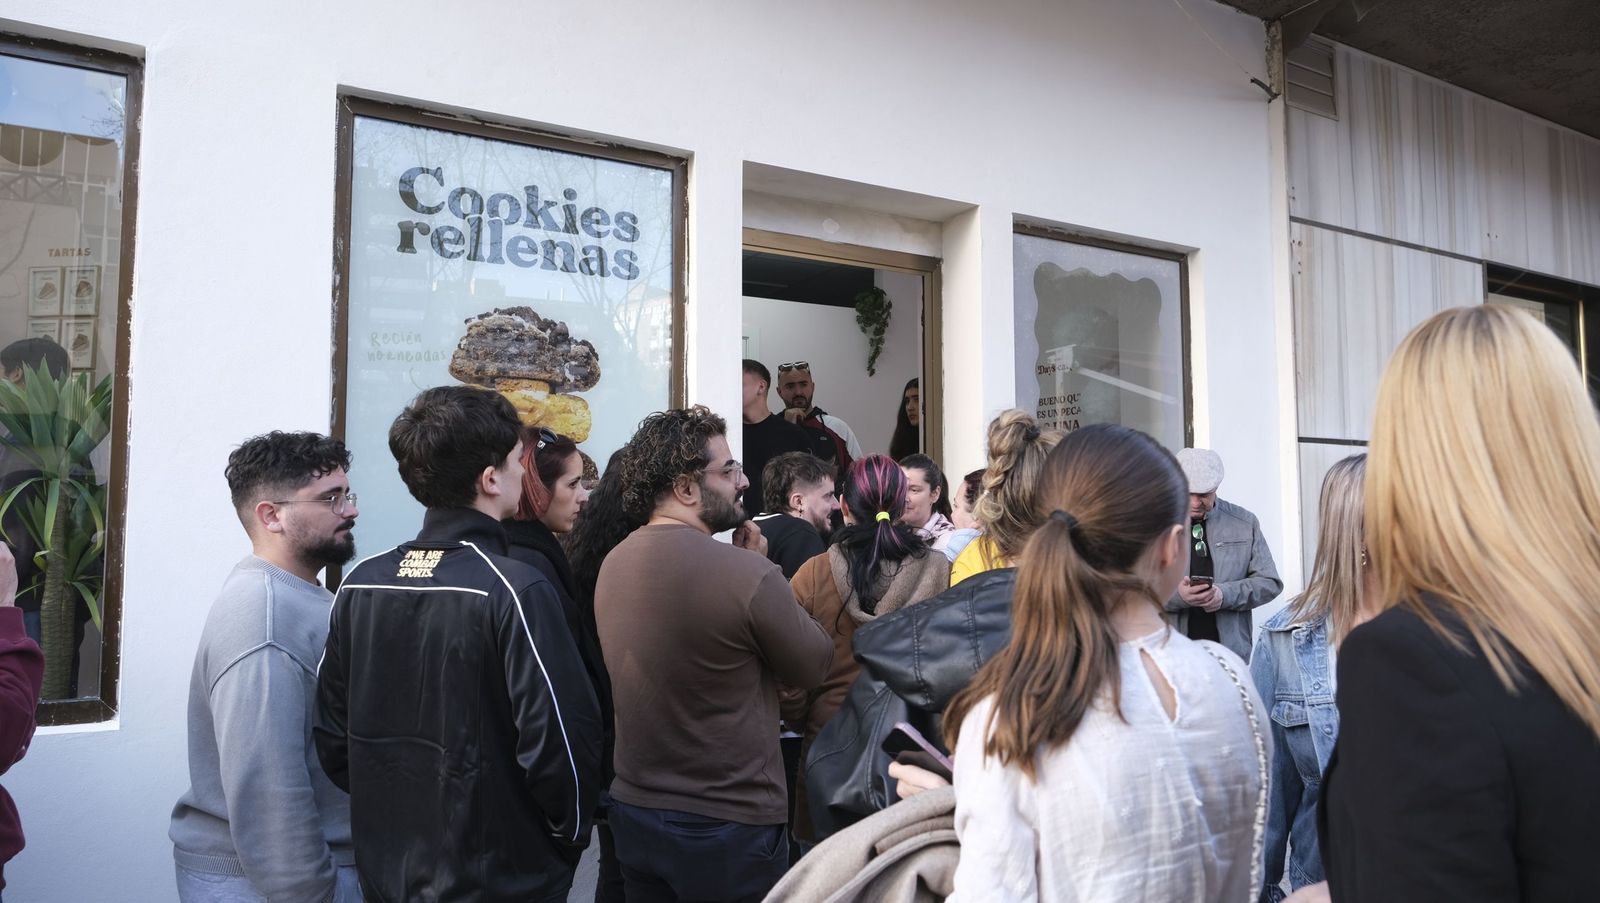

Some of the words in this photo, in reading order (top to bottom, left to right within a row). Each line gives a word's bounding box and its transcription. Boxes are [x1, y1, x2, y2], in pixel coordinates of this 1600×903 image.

[398, 166, 641, 243] Cookies
[47, 247, 92, 258] TARTAS
[396, 216, 641, 281] rellenas
[426, 550, 445, 559] ARE
[399, 559, 440, 568] COMBAT
